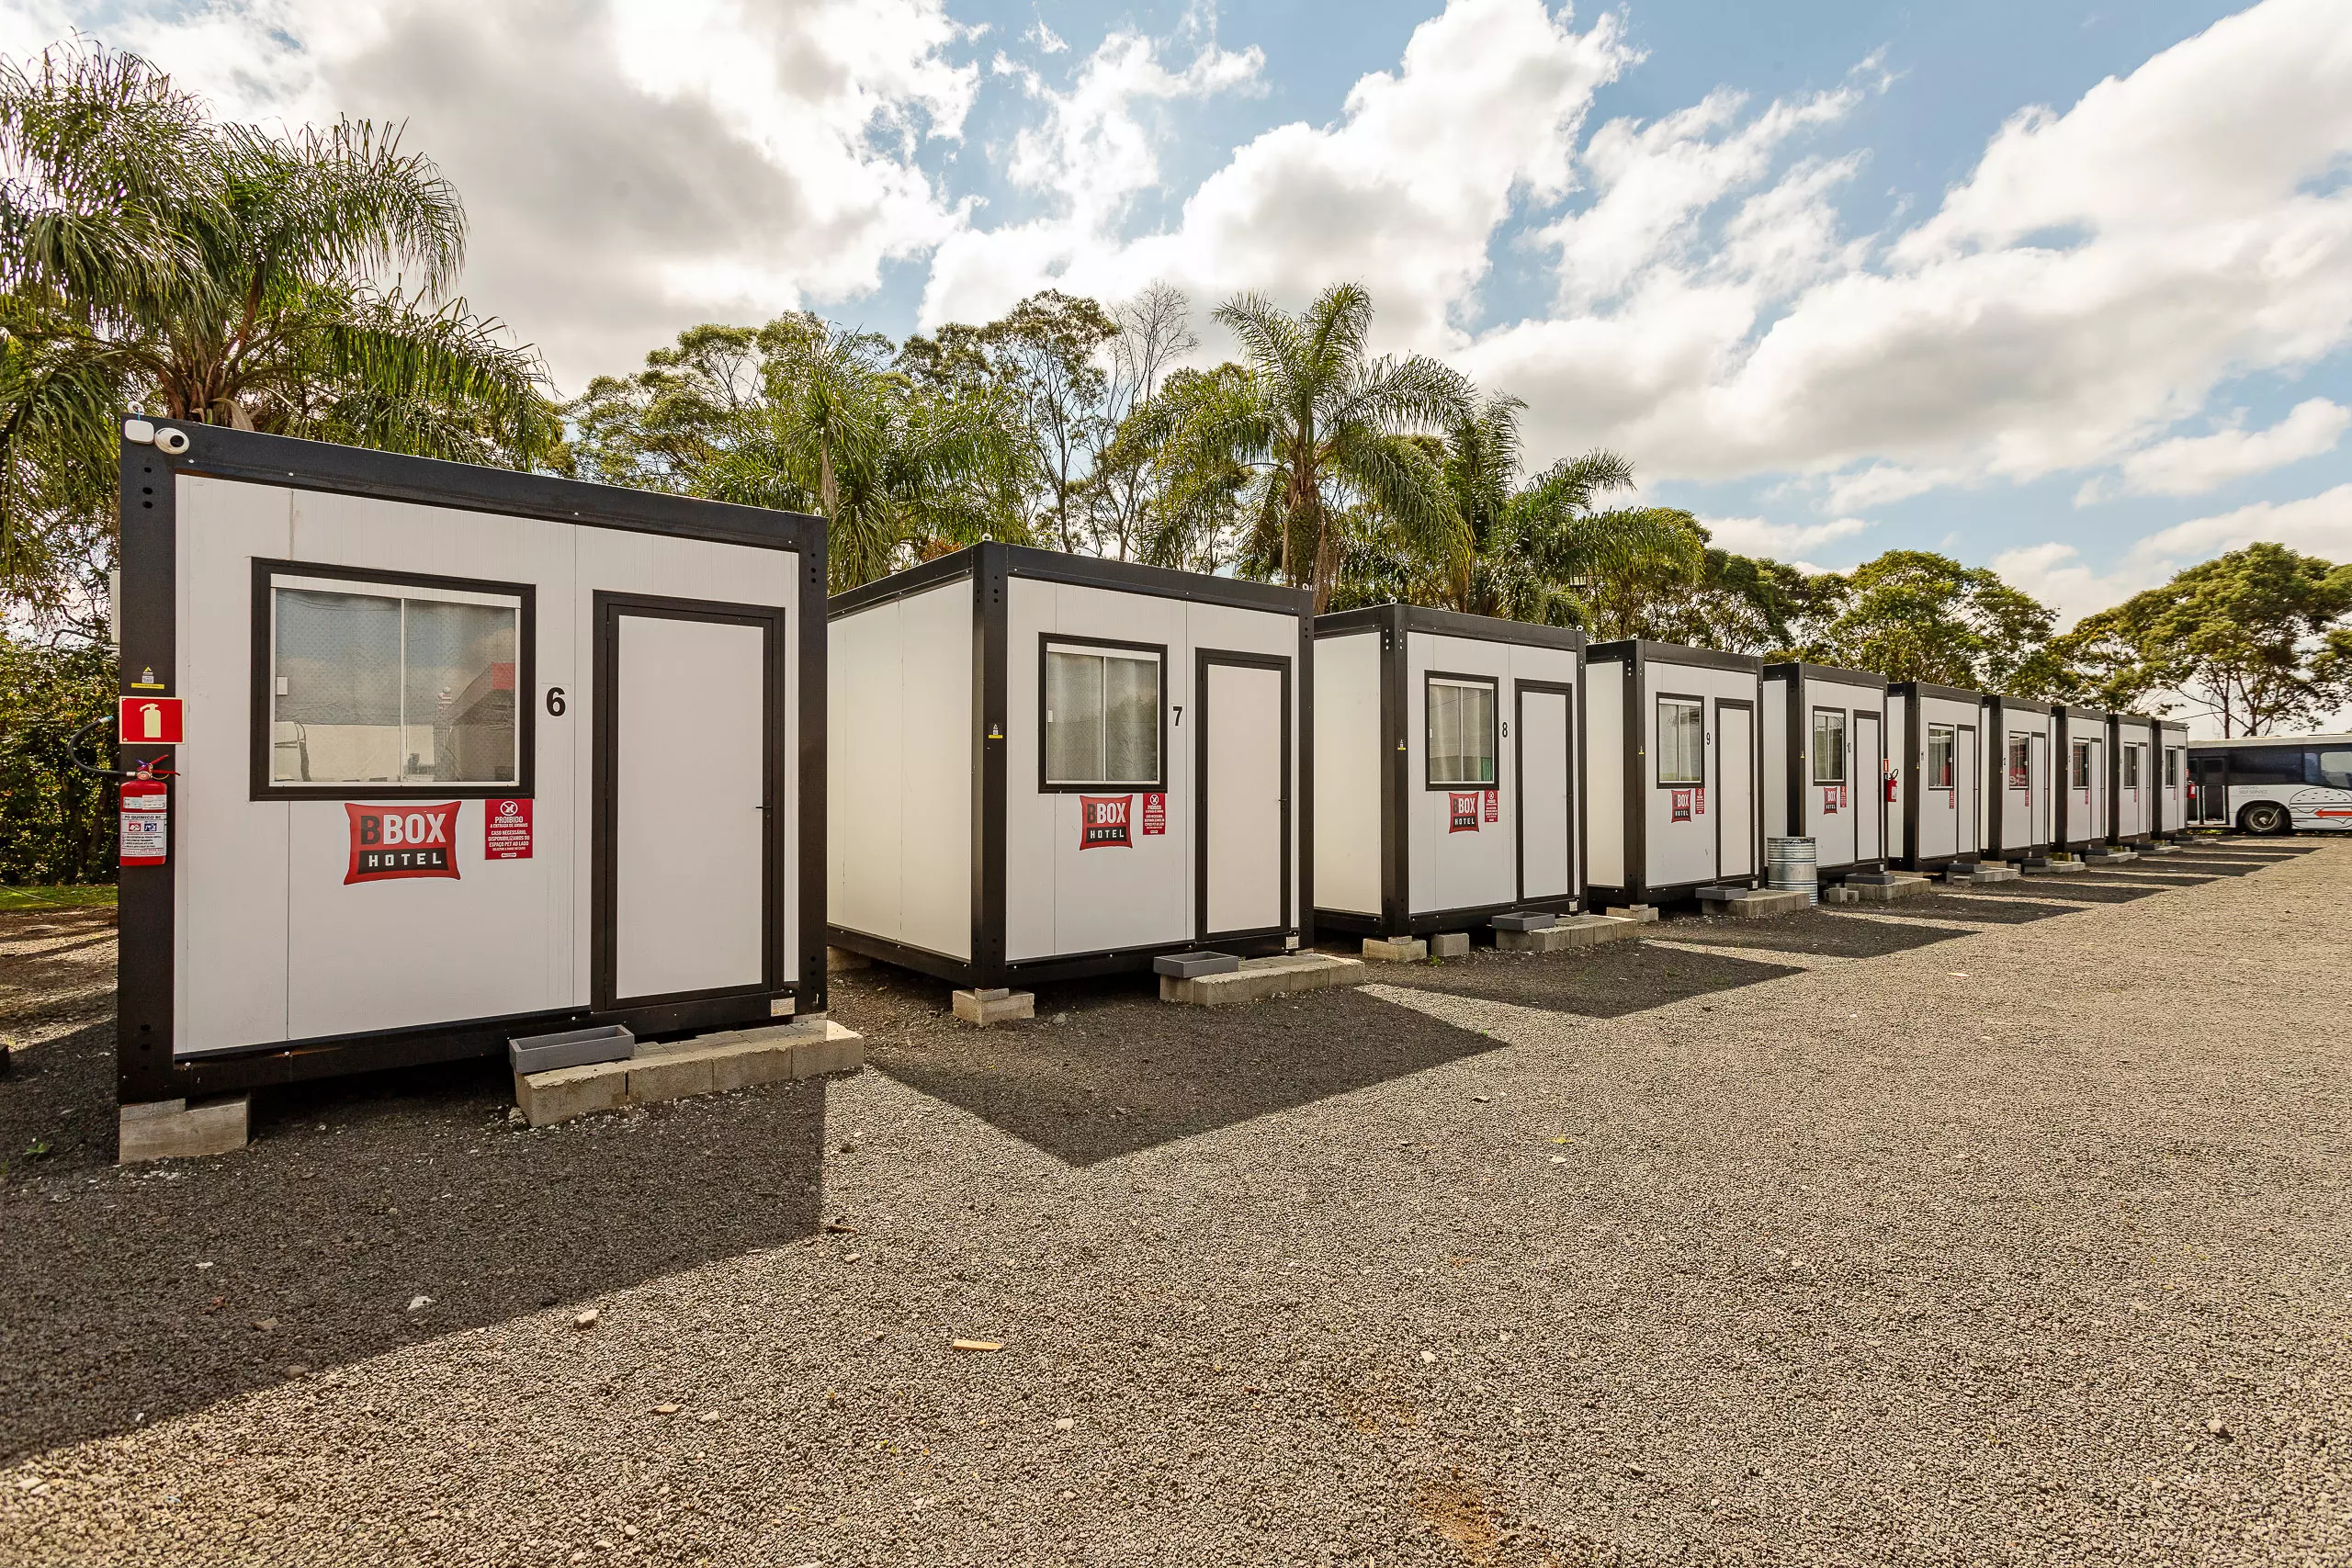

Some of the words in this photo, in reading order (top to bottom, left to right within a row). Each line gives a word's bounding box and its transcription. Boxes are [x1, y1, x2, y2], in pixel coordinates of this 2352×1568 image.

[547, 687, 566, 716] 6
[1172, 705, 1182, 727] 7
[1502, 721, 1509, 739] 8
[1706, 732, 1711, 745] 9
[1826, 791, 1836, 802] BOX
[1087, 802, 1126, 824] BBOX
[1453, 797, 1476, 814] BBOX
[361, 813, 447, 846] BBOX
[1454, 818, 1475, 826] HOTEL
[1090, 829, 1125, 839] HOTEL
[368, 852, 442, 867] HOTEL
